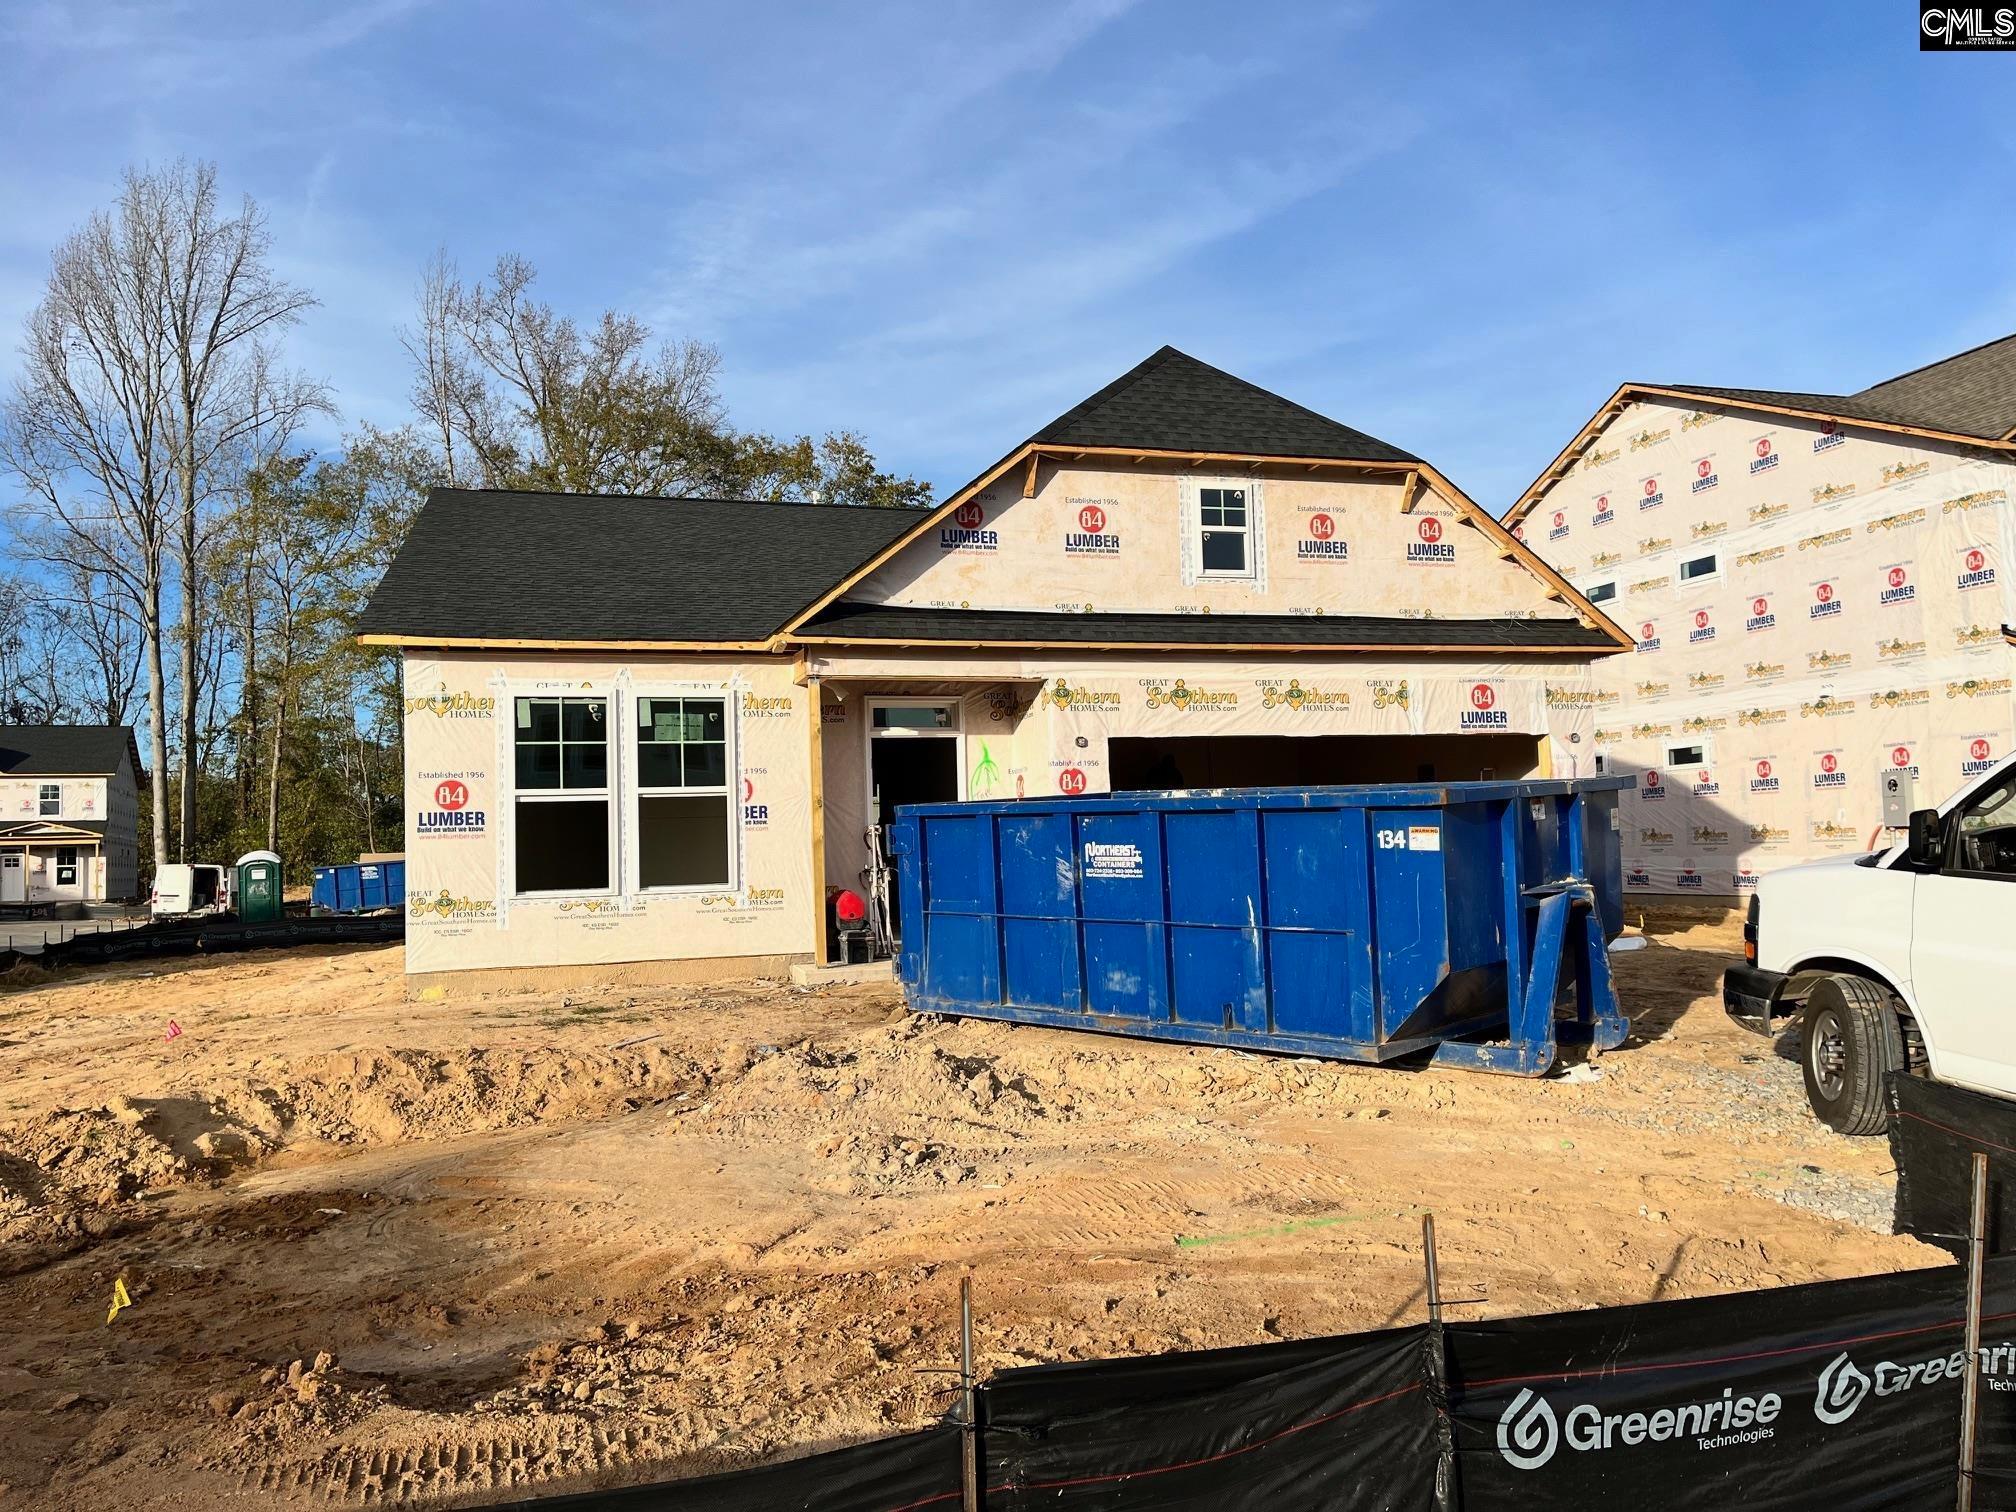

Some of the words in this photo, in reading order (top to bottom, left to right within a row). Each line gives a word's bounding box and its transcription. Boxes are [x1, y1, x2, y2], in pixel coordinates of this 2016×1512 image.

[1814, 431, 1845, 449] LUMBER
[1750, 454, 1779, 471] LUMBER
[1692, 475, 1718, 490] LUMBER
[1065, 497, 1102, 505] Established
[1103, 498, 1119, 506] 1956
[1639, 493, 1663, 507] LUMBER
[957, 506, 980, 524] 84
[1297, 505, 1331, 513] Established
[1332, 506, 1347, 514] 1956
[1082, 511, 1103, 528] 84
[1592, 510, 1614, 524] LUMBER
[1312, 518, 1332, 535] 84
[1421, 522, 1440, 538] 84
[1549, 525, 1569, 538] LUMBER
[941, 529, 998, 544] LUMBER
[1066, 534, 1120, 548] LUMBER
[1298, 540, 1348, 554] LUMBER
[1407, 543, 1455, 557] LUMBER
[1966, 554, 1983, 568] 84
[1889, 571, 1905, 586] 84
[1957, 568, 1996, 585] LUMBER
[1880, 585, 1915, 600] LUMBER
[930, 600, 955, 608] GREAT
[1056, 603, 1080, 611] GREAT
[1288, 606, 1312, 614] GREAT
[1810, 600, 1842, 615] LUMBER
[1398, 608, 1420, 616] GREAT
[1746, 614, 1776, 628] LUMBER
[1689, 626, 1716, 639] LUMBER
[1637, 638, 1661, 650] LUMBER
[1254, 679, 1284, 687] GREAT
[1946, 676, 2013, 699] Southern
[1146, 686, 1238, 710] Southern
[1262, 686, 1350, 710] Southern
[1473, 689, 1492, 705] 84
[1869, 688, 1931, 709] Southern
[1069, 704, 1120, 712] HOMES.com
[1461, 711, 1508, 724] LUMBER
[1893, 749, 1908, 764] 84
[1972, 743, 1988, 758] 84
[1083, 759, 1100, 767] 1956
[1822, 757, 1836, 770] 84
[418, 771, 464, 779] Established
[466, 771, 485, 779] 1956
[1061, 773, 1084, 791] 84
[1814, 772, 1846, 784] LUMBER
[1693, 782, 1719, 793] LUMBER
[1750, 777, 1779, 788] LUMBER
[438, 785, 465, 805] 84
[1641, 786, 1666, 796] LUMBER
[418, 811, 486, 827] LUMBER
[1377, 829, 1406, 849] 134
[1676, 875, 1702, 884] LUMBER
[1564, 1387, 1783, 1451] Greenrise
